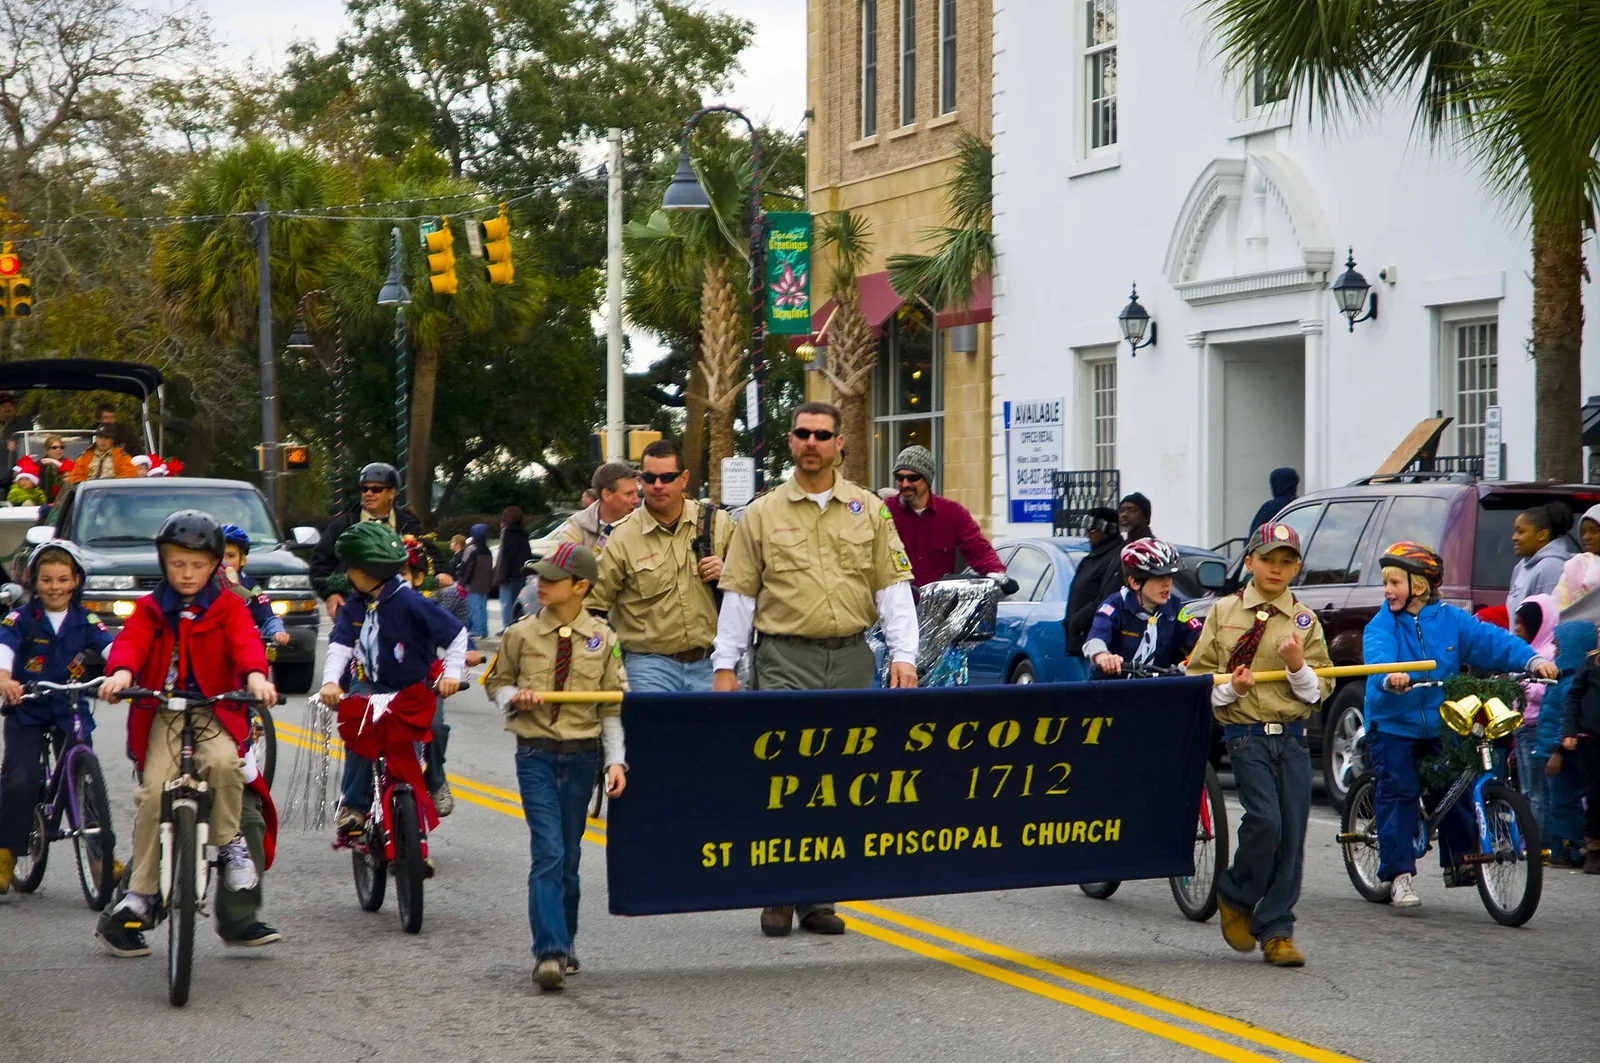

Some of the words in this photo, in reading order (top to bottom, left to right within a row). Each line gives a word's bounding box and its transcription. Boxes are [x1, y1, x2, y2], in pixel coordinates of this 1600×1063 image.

[1015, 401, 1059, 425] AVAILABLE
[753, 727, 877, 761] CUB
[905, 716, 1113, 752] SCOUT
[767, 769, 922, 809] PACK
[966, 762, 1072, 799] 1712
[701, 842, 733, 868] ST
[750, 836, 846, 867] HELENA
[864, 825, 1003, 857] EPISCOPAL
[1021, 818, 1121, 847] CHURCH
